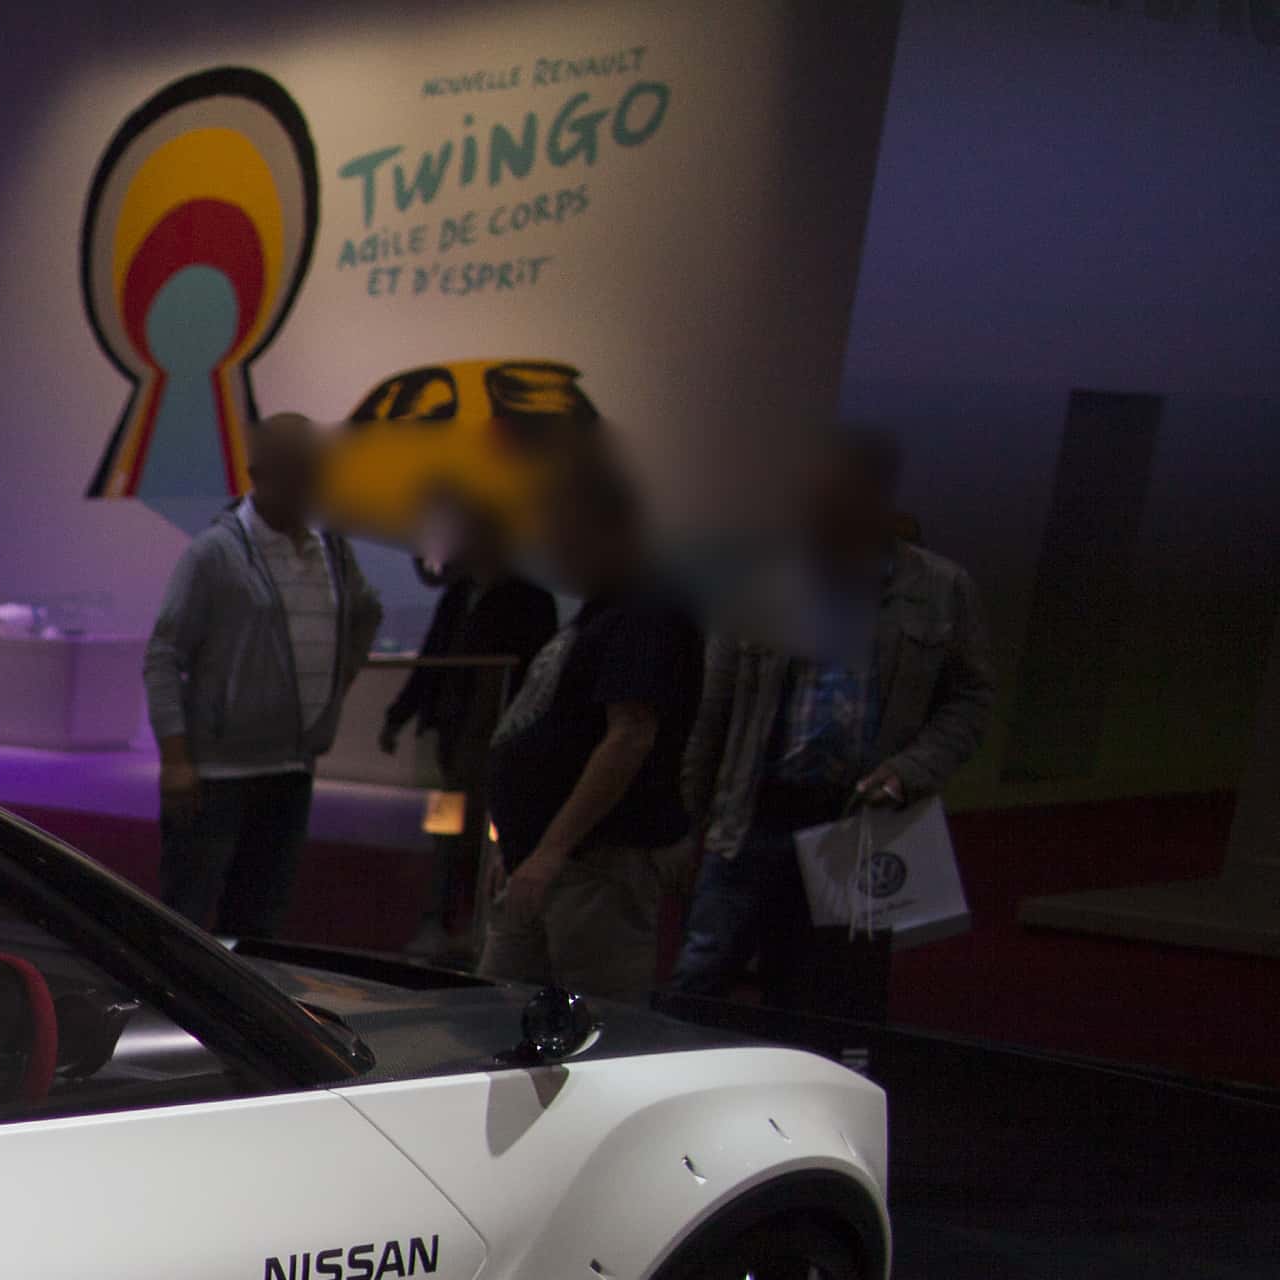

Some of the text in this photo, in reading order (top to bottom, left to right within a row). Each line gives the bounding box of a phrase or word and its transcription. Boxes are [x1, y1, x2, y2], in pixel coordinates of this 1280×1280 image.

[532, 46, 648, 86] RENAULT
[439, 210, 477, 253] DE
[487, 183, 590, 236] CORPS
[367, 265, 403, 298] ET
